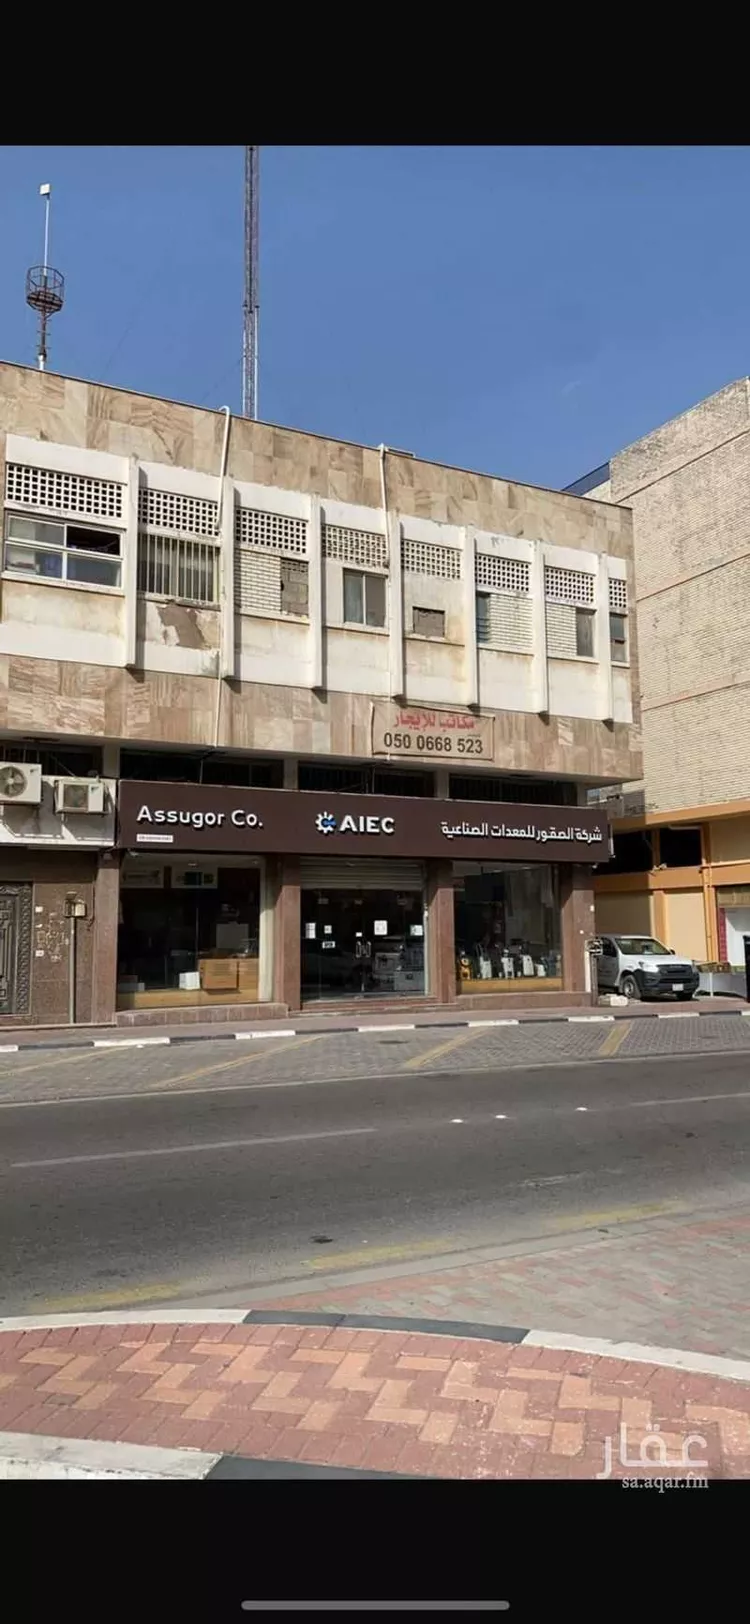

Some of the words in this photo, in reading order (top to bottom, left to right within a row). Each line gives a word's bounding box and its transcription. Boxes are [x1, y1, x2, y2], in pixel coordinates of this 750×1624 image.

[440, 714, 475, 732] مكاتب
[384, 732, 411, 749] 050
[416, 735, 452, 752] 0668
[457, 738, 483, 754] 523
[136, 805, 225, 828] Assugor
[231, 809, 263, 827] Co.
[339, 815, 395, 833] AIEC
[441, 821, 488, 838] الصناعية
[490, 823, 535, 838] للمعدات
[536, 827, 574, 842] الصقور
[575, 826, 602, 843] شركة
